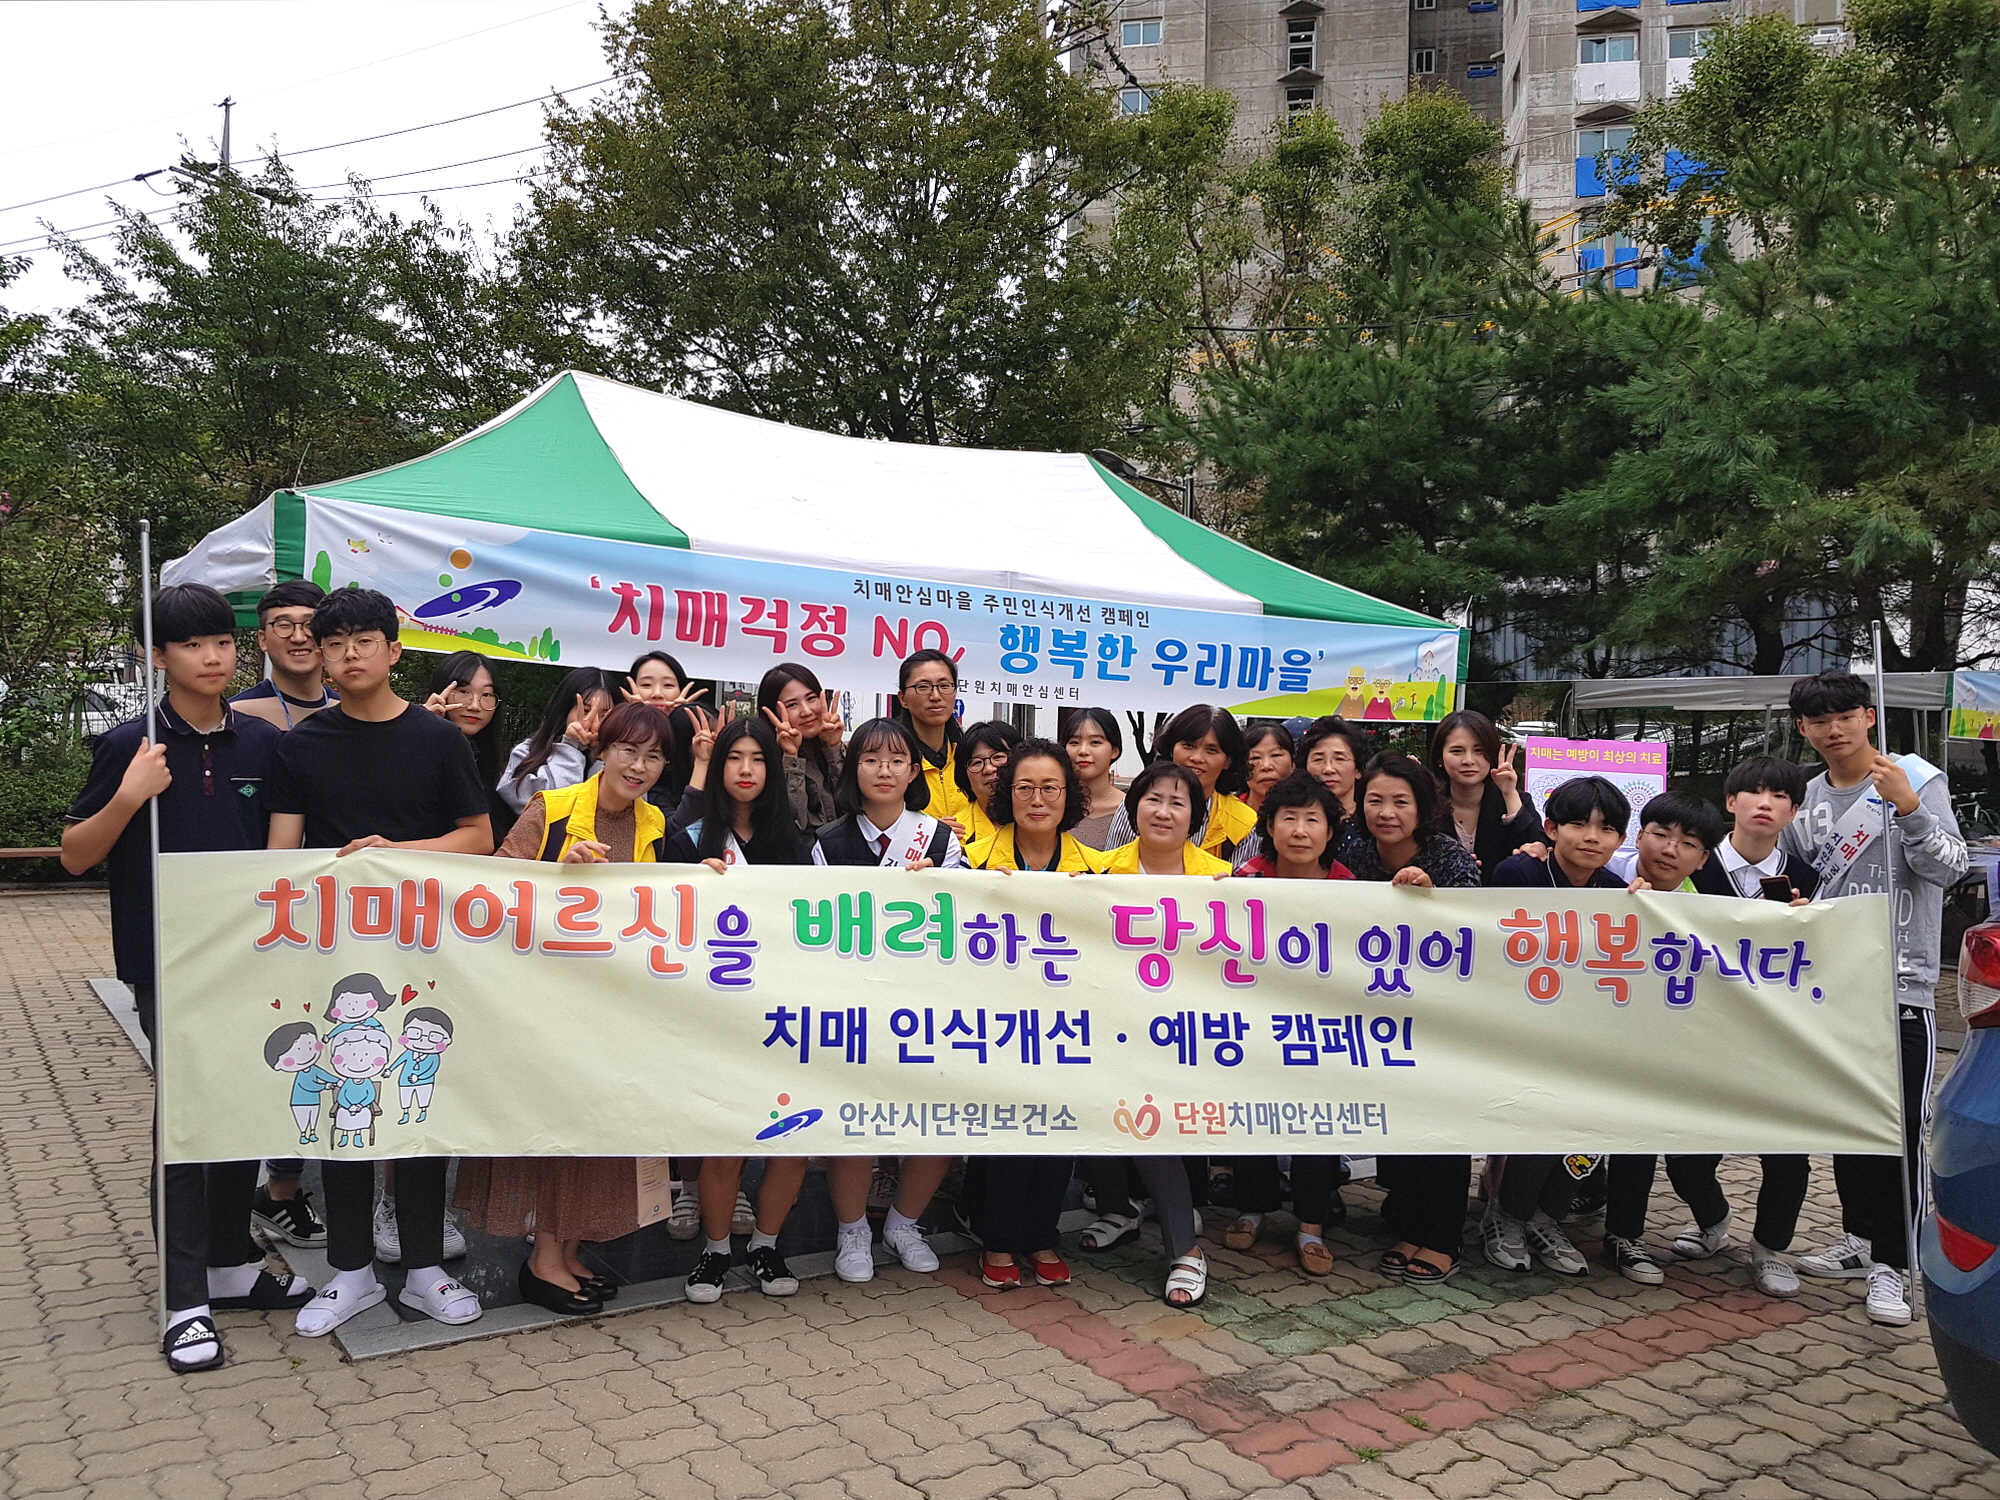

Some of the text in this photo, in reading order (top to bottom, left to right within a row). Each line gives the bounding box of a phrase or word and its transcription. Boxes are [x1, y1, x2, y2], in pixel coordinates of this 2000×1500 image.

[853, 580, 1149, 628] 치매안심마을 주민인식개선 캠페인
[1000, 624, 1137, 682] 행복한
[958, 679, 1080, 700] 단원치매안심센터
[1530, 747, 1663, 765] 치매는 예방이 최상의 치료
[255, 875, 1825, 1004] 치매어르신을 배려하는 당신이 있어 행복합니다.
[762, 1005, 867, 1064] 치매
[889, 1007, 1091, 1065] 인식개선
[1149, 1011, 1250, 1067] 예방
[1271, 1013, 1416, 1067] 캠페인
[839, 1102, 1078, 1137] 안산시단원보건소
[1173, 1101, 1389, 1136] 단원치매안심센터
[173, 1331, 216, 1347] adidas
